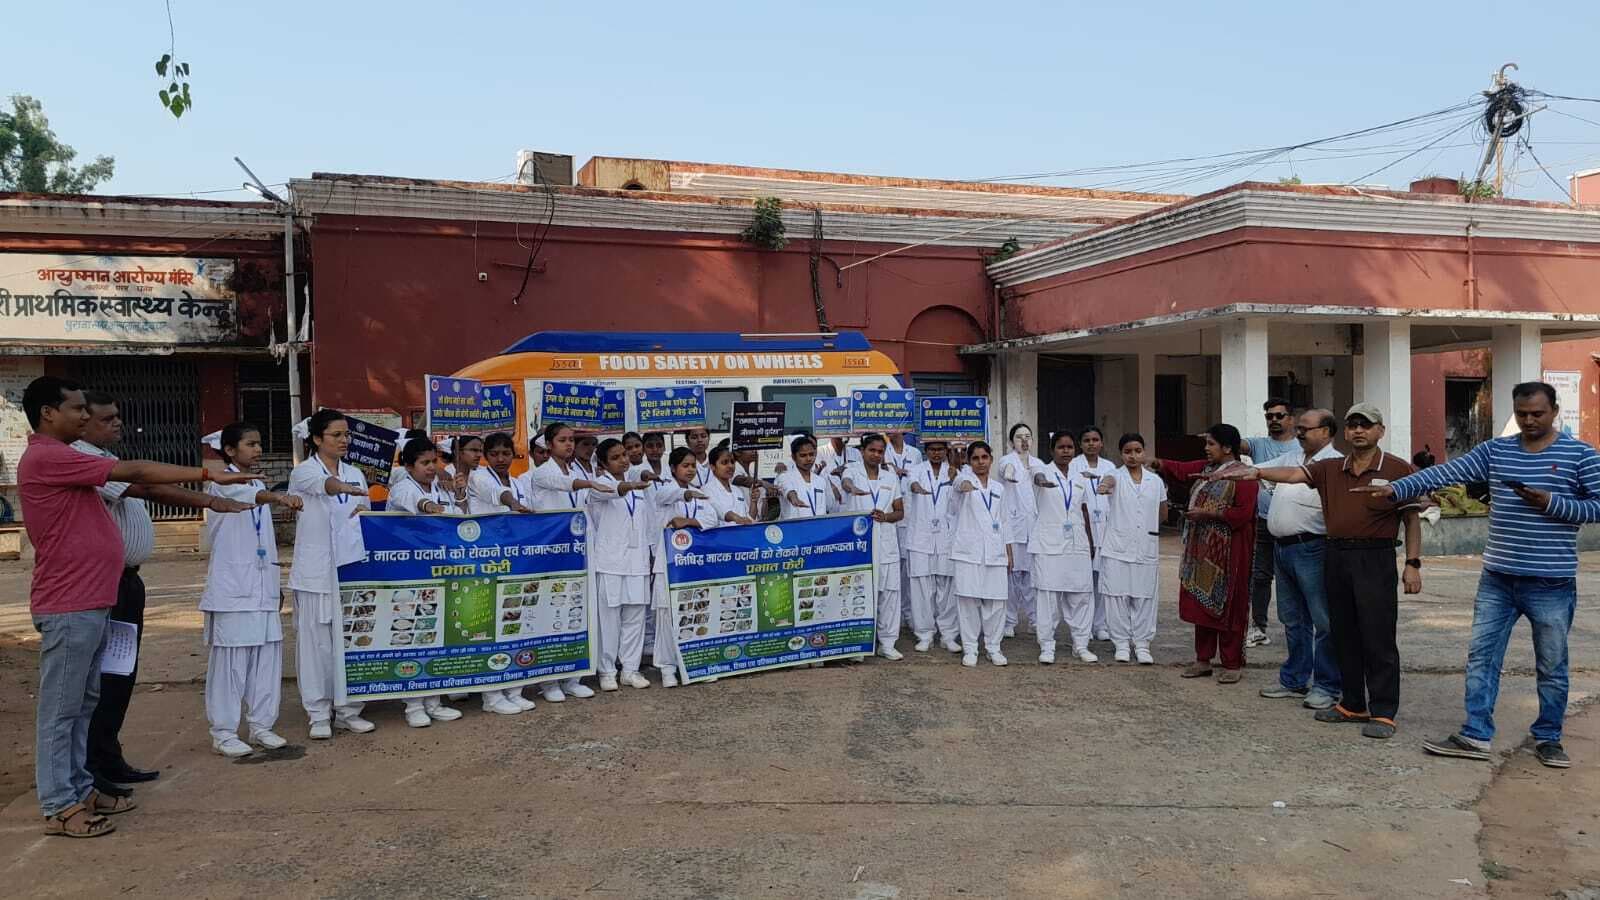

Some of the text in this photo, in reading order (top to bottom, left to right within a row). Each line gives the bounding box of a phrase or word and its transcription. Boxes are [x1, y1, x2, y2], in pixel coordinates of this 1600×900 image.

[37, 268, 110, 286] आयुष्मान
[112, 265, 167, 284] आरोग्य
[168, 268, 194, 286] मंदिर
[14, 288, 98, 317] प्राथमिक
[99, 297, 175, 321] स्वास्थ्य
[599, 353, 824, 370] FOOD SAFETY ON WHEELS
[374, 549, 411, 562] मादक
[449, 544, 466, 560] को
[469, 543, 501, 559] रोकने
[504, 543, 519, 557] एवं
[522, 543, 570, 556] जागरूकता
[573, 539, 586, 556] हेतु
[674, 552, 704, 567] निषिद्ध
[706, 552, 733, 564] मादक
[761, 546, 774, 559] को
[775, 545, 799, 559] रोकने
[800, 545, 813, 556] एवं
[814, 541, 854, 554] जागरूकता
[856, 538, 868, 553] हेतु
[431, 559, 512, 577] प्रभात फेरी
[746, 557, 805, 574] प्रभात फेरी
